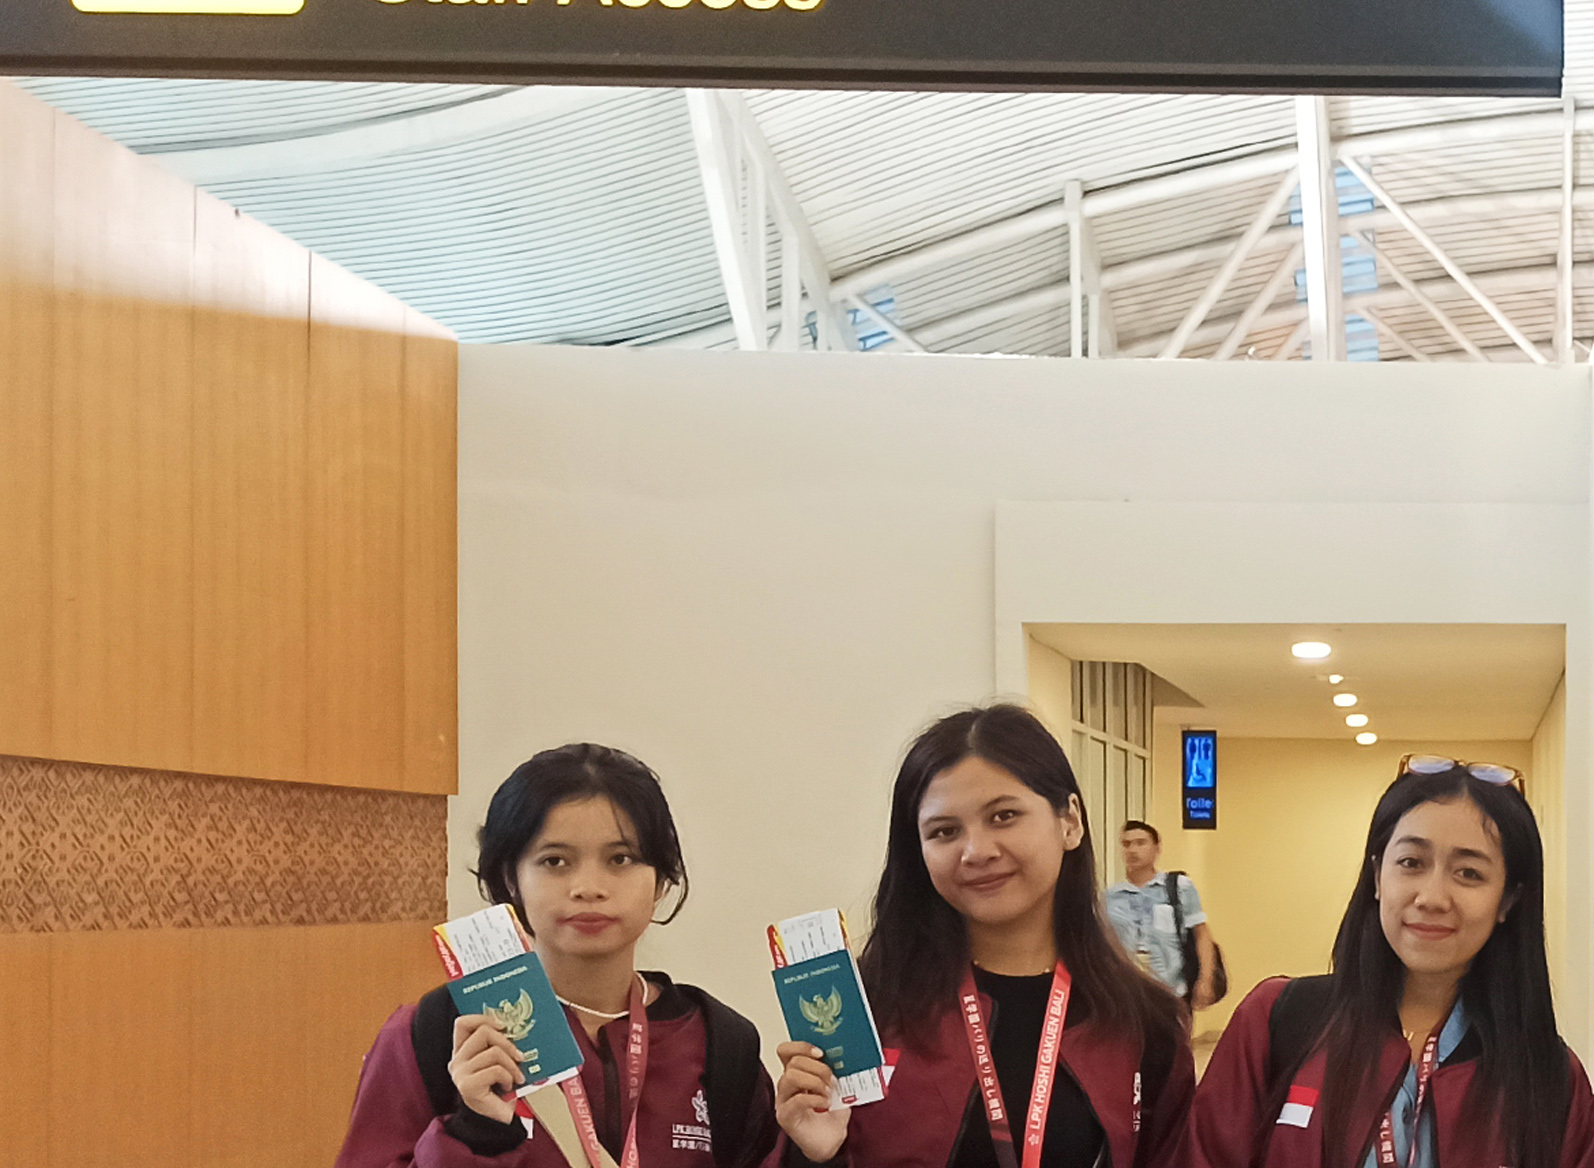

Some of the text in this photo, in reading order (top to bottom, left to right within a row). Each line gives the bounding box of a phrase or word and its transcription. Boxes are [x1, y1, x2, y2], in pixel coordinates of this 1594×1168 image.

[1030, 989, 1065, 1130] LPK HOSHI GAKUEN BALI
